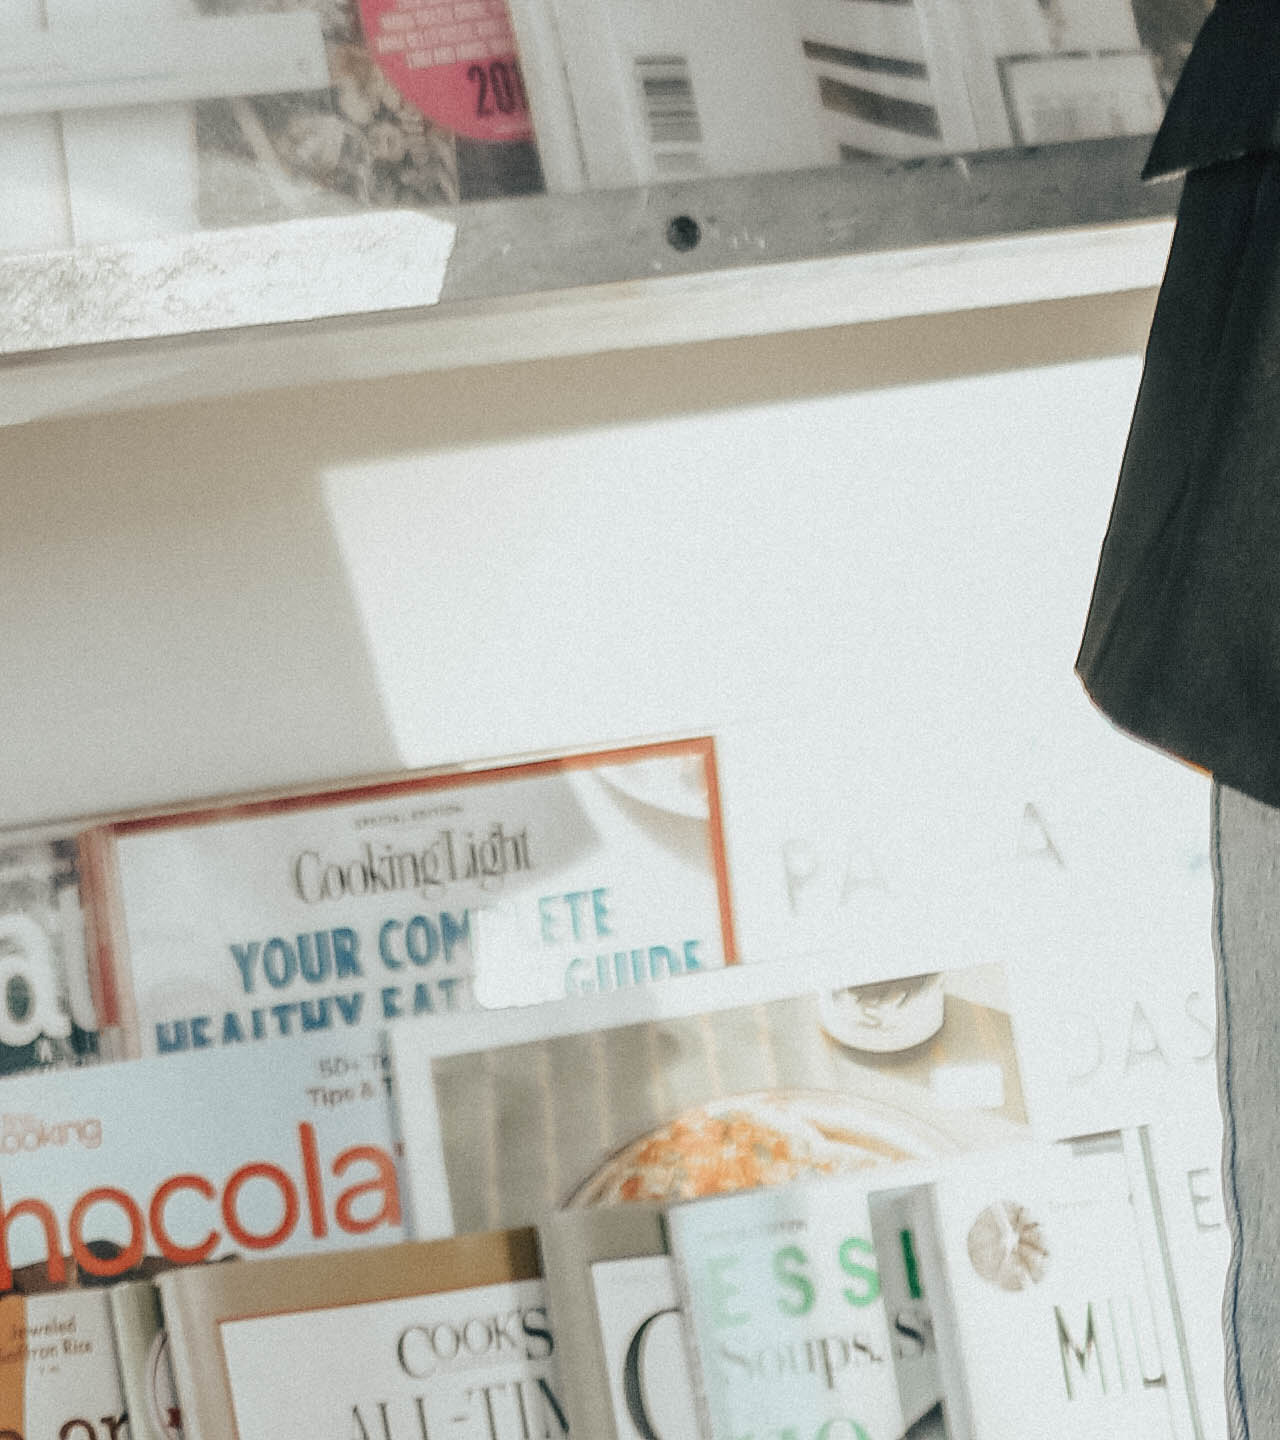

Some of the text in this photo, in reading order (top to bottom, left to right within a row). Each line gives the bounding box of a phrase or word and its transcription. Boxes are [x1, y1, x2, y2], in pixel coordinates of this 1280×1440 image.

[293, 821, 534, 907] Cooking Light
[228, 885, 616, 996] YOUR COMETE
[396, 1306, 555, 1380] COOK'S
